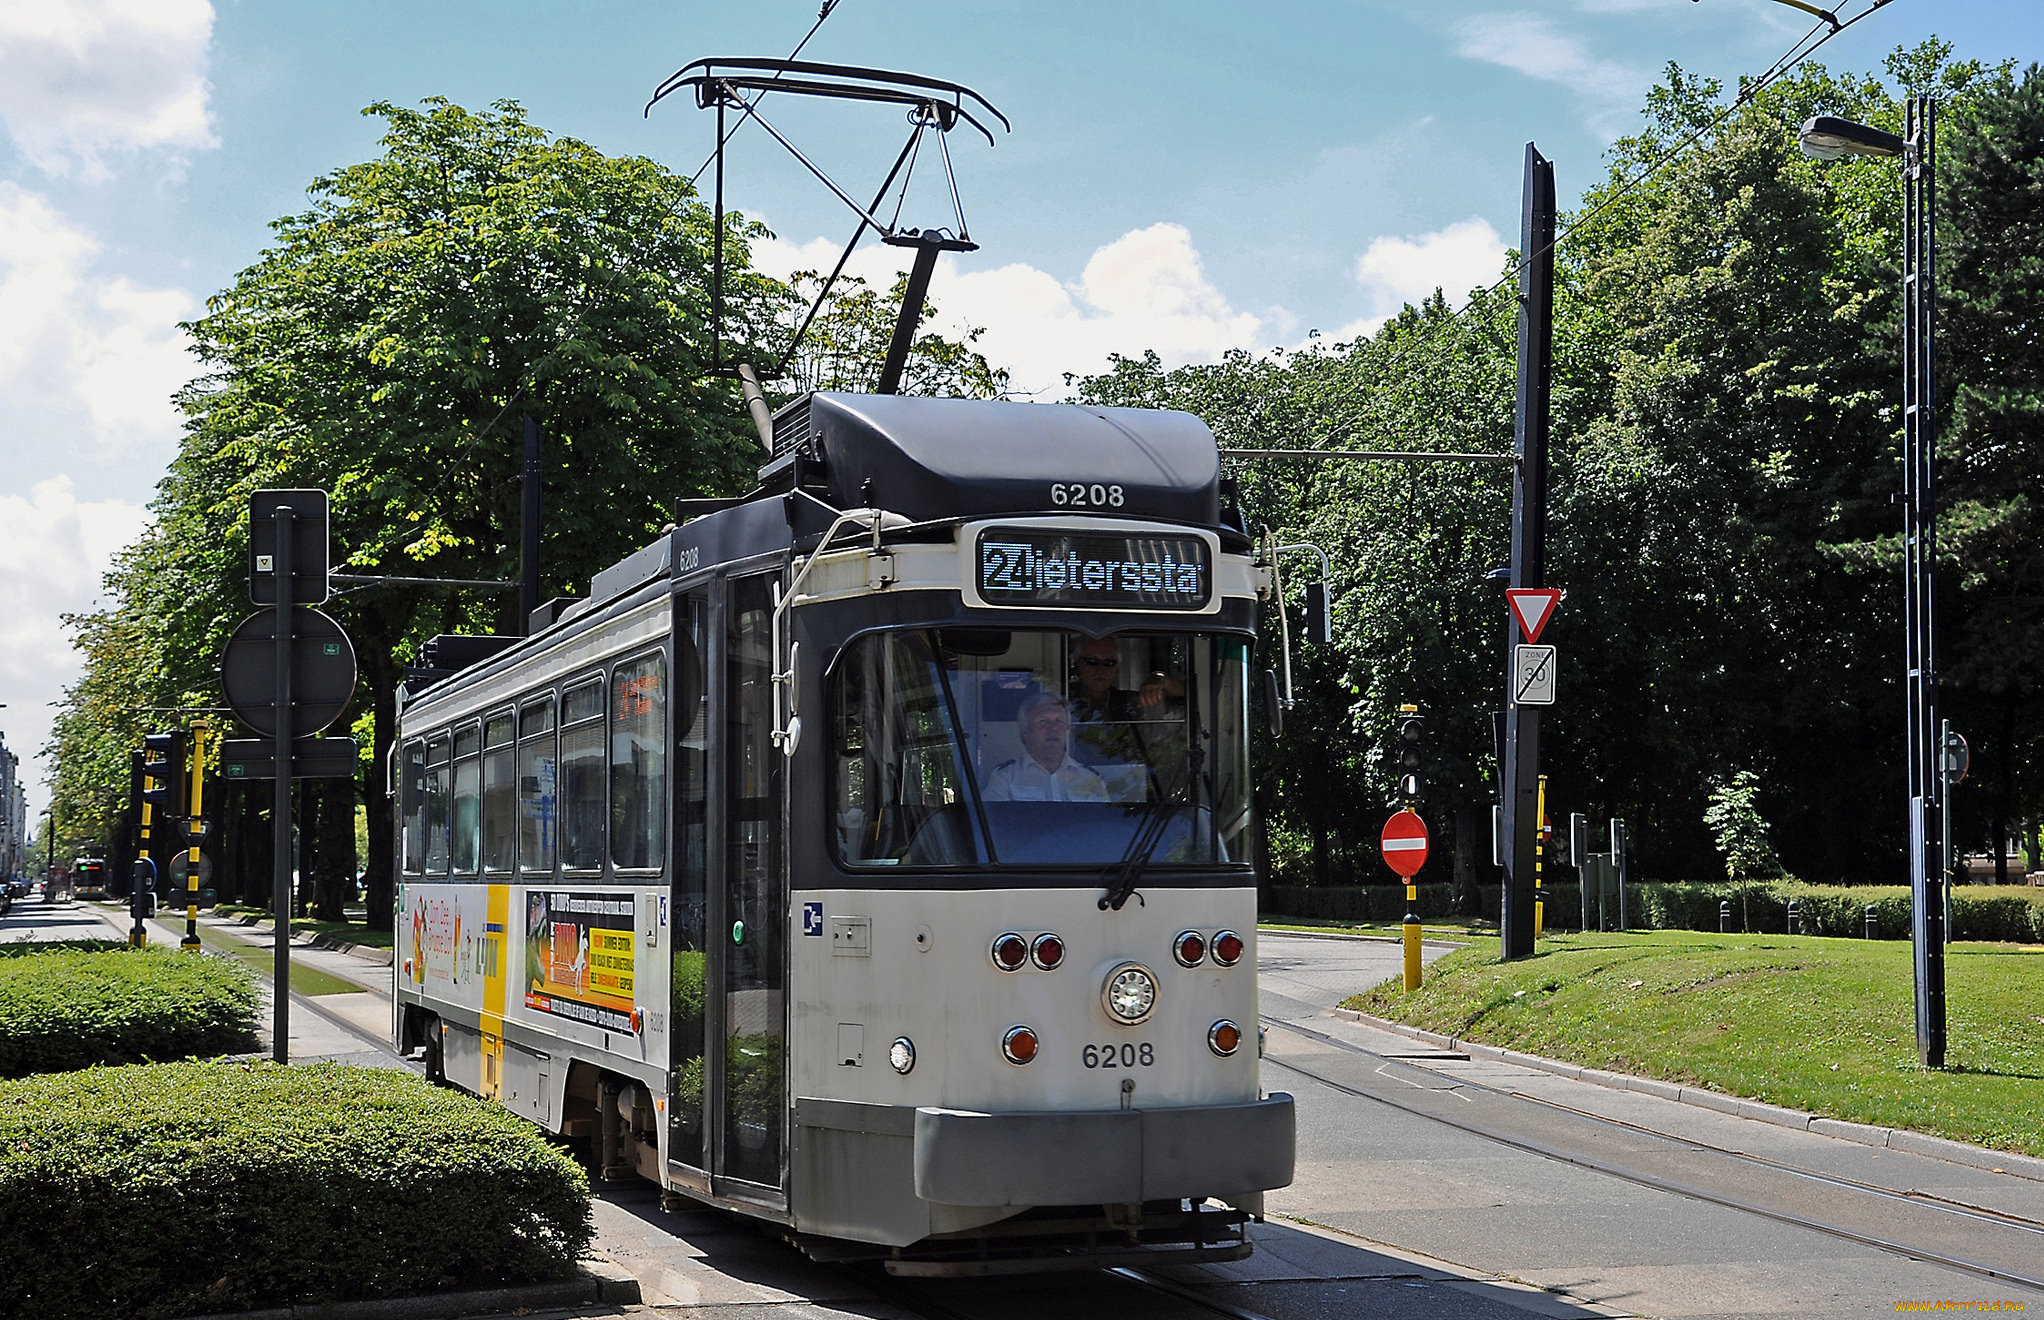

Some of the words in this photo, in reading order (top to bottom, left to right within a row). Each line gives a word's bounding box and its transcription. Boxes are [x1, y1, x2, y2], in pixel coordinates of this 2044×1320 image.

[1050, 483, 1125, 507] 6208
[680, 546, 699, 572] 6208
[986, 546, 1031, 588] 24
[1524, 667, 1546, 682] 30
[1082, 1042, 1155, 1070] 6208
